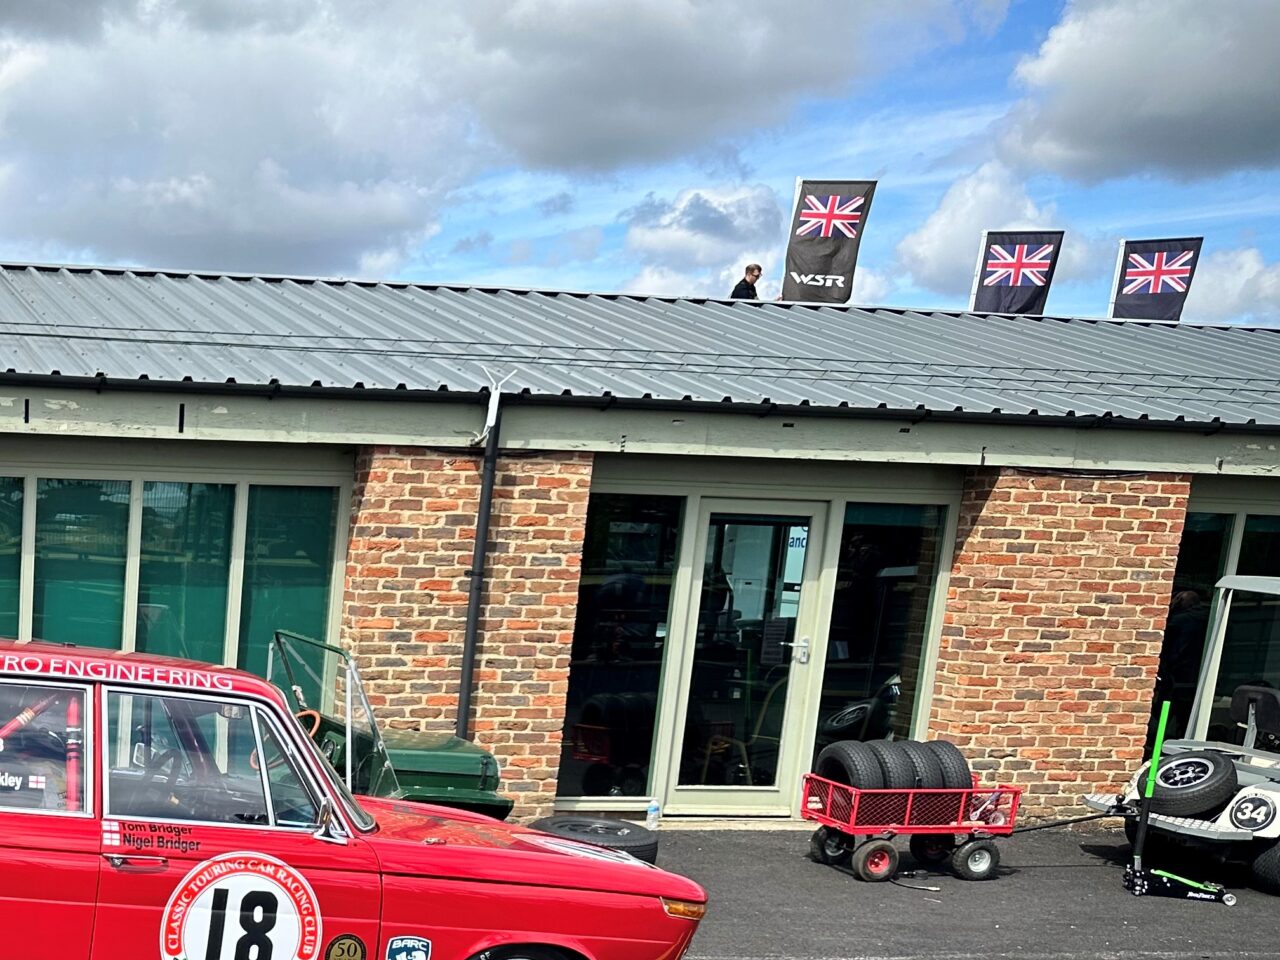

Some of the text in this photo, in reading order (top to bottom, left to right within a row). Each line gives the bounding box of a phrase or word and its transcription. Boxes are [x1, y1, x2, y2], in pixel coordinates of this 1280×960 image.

[790, 271, 845, 288] WSR
[48, 658, 233, 690] ENGINEERING
[1236, 802, 1268, 823] 34
[120, 821, 193, 836] Tom Bridger
[122, 832, 201, 853] Nigel Bridger
[168, 891, 193, 949] CLASSIC
[189, 860, 245, 891] TOURING
[247, 860, 276, 875] CAR
[276, 869, 313, 916] RACING
[302, 916, 316, 955] CLUB
[335, 942, 358, 958] 50
[391, 939, 428, 951] BARC
